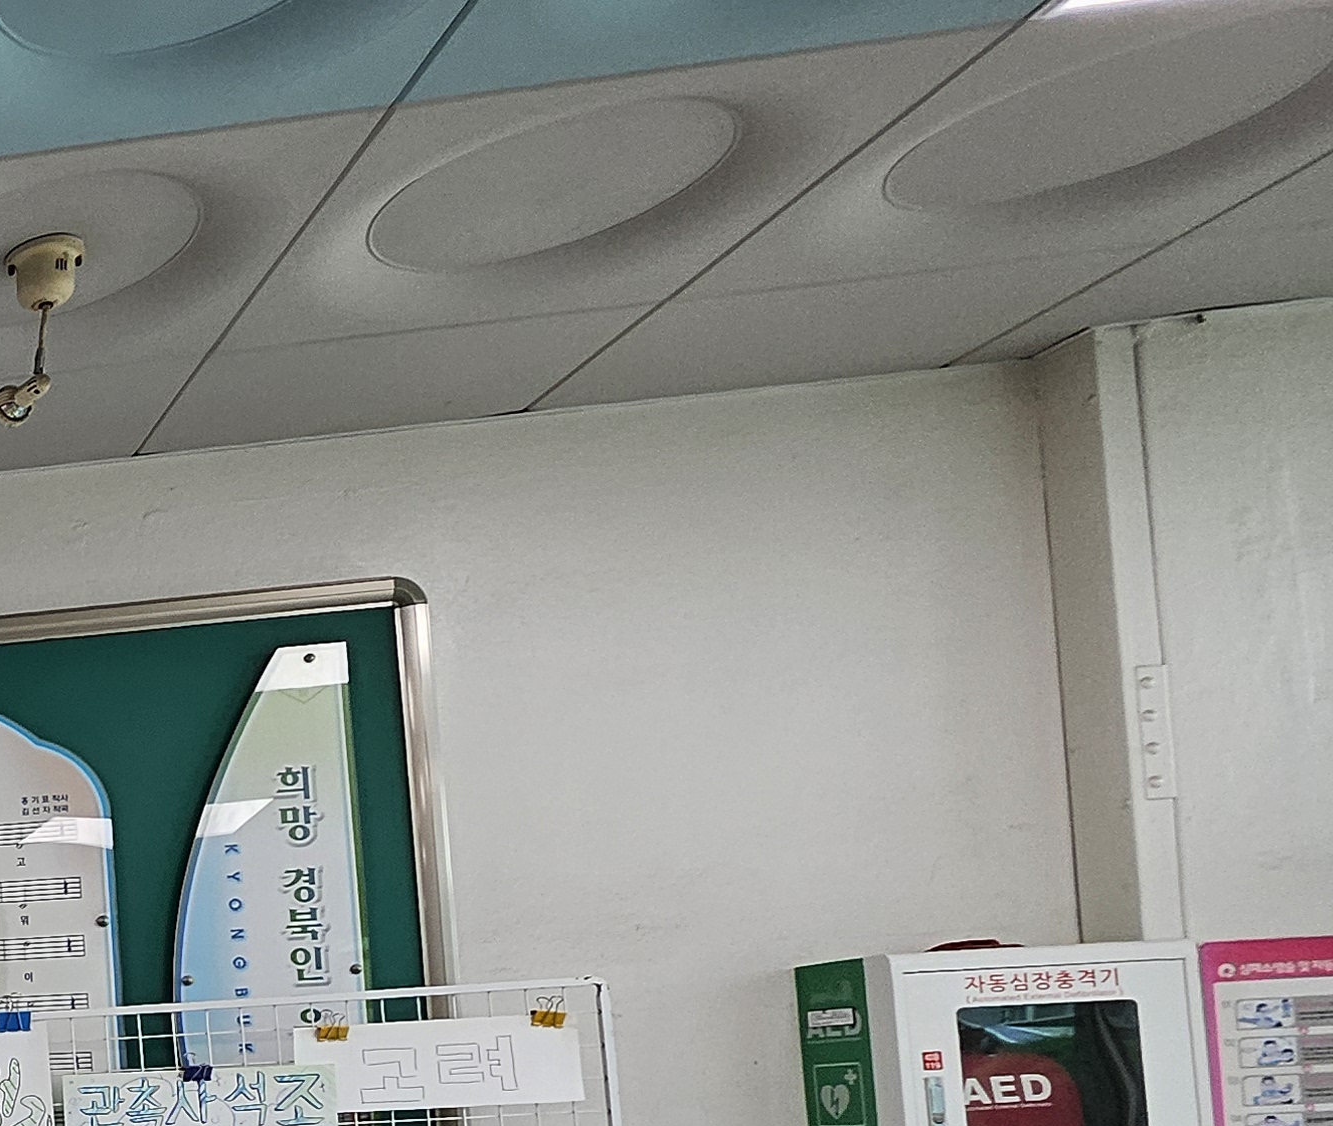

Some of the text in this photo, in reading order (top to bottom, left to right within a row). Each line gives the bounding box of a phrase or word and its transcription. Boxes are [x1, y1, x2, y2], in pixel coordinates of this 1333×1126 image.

[52, 794, 69, 802] 작사
[276, 766, 318, 842] 희망
[224, 843, 254, 1054] KYONGBUK
[283, 867, 324, 981] 경북인
[964, 968, 1120, 993] 자동심장충격기
[360, 1034, 520, 1104] 고려
[964, 1073, 1052, 1106] AED
